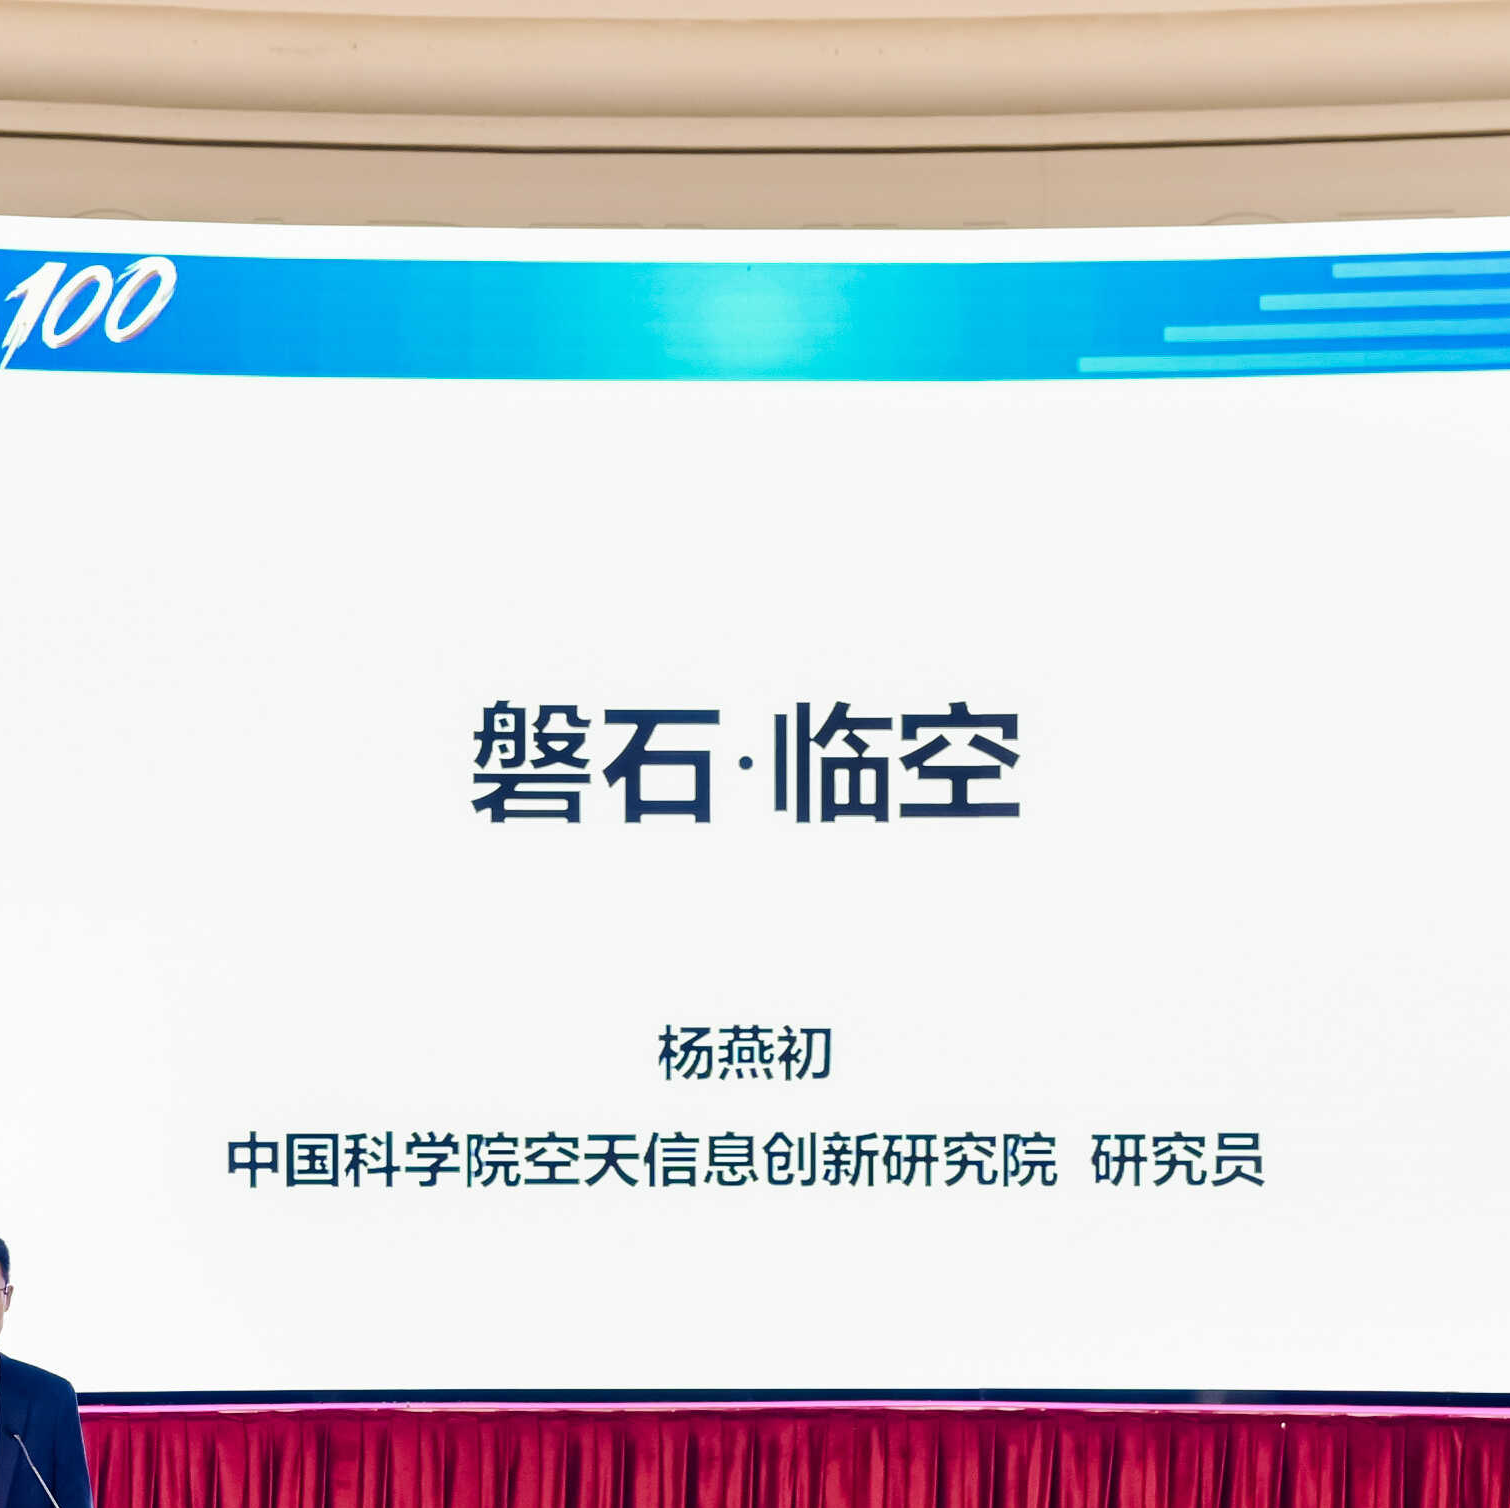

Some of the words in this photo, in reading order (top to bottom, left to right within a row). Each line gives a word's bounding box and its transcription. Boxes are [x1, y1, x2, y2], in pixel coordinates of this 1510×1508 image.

[471, 700, 1021, 824] 磐石·临空
[658, 1024, 833, 1082] 杨燕初
[227, 1131, 1059, 1189] 中国科学院空天信息创新研究院
[1091, 1132, 1266, 1188] 研究员
